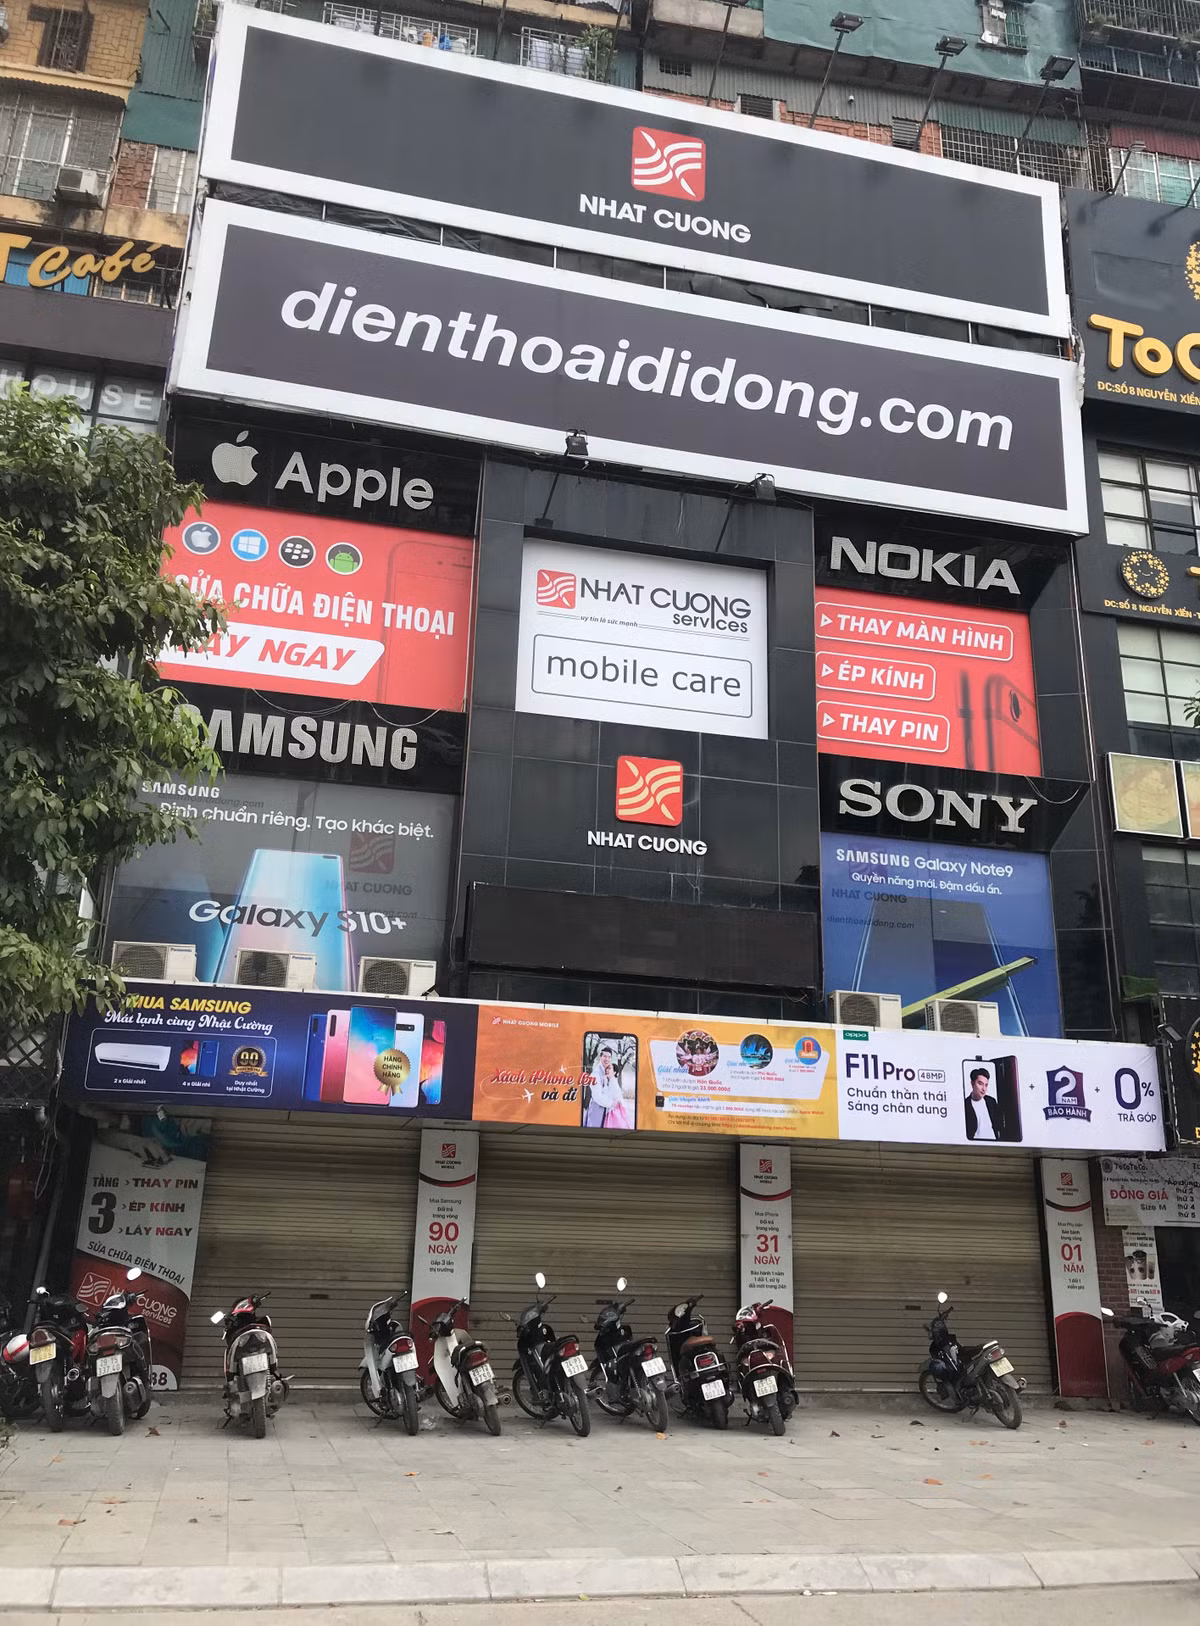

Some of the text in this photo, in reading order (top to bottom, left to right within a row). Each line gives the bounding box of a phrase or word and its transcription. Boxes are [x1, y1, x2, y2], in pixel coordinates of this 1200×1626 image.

[579, 193, 752, 243] NHAT CUONG
[27, 241, 163, 287] Café
[281, 283, 1013, 451] dienthoaididong.com
[1137, 388, 1177, 402] NGUYỄN
[275, 451, 435, 510] Apple
[830, 536, 1021, 594] NOKIA
[580, 577, 751, 619] NHAT CUONG
[234, 582, 305, 616] CHỮA
[312, 592, 373, 627] ĐIỆN
[382, 603, 455, 639] THOẠI
[672, 611, 748, 633] services
[837, 613, 1004, 650] THAY MÀN HÌNH
[258, 638, 356, 671] NGAY
[547, 655, 741, 697] mobile care
[838, 660, 925, 690] ÉP KÍNH
[840, 713, 939, 741] THAY PIN
[142, 781, 220, 798] SAMSUNG
[839, 778, 1038, 834] SONY
[202, 805, 258, 823] chuẩn
[262, 809, 311, 832] riêng.
[316, 815, 348, 834] Tạo
[352, 814, 395, 835] khác
[398, 821, 434, 840] biệt.
[587, 830, 707, 855] NHAT CUONG
[836, 848, 910, 867] SAMSUNG
[914, 856, 967, 877] Galaxy
[971, 862, 1014, 878] Note9
[362, 882, 413, 896] CUONG
[851, 871, 1003, 895] Quyền năng mới. Đậm dấu ấn.
[831, 887, 908, 904] NHAT CUONG
[189, 900, 329, 937] Galaxy
[338, 909, 408, 935] S10+
[170, 997, 252, 1014] SAMSUNG
[104, 1010, 273, 1035] Mát lạnh cùng Nhật Cường
[529, 1069, 575, 1086] iPhone
[845, 1052, 944, 1082] F11 Pro 48MP
[541, 1087, 578, 1102] và đi
[847, 1085, 947, 1102] Chuẩn thần thái
[1054, 1069, 1077, 1104] 2
[1114, 1067, 1155, 1110] 0%
[847, 1100, 948, 1119] Sáng chân dung
[1065, 1105, 1087, 1118] HÀNH
[1117, 1111, 1157, 1123] TRẢ GÓP
[133, 1178, 172, 1188] THAY
[175, 1179, 199, 1189] PIN
[1147, 1187, 1168, 1201] GIÁ
[88, 1191, 186, 1235] 3 ÉP KÍNH
[1140, 1203, 1157, 1211] Size
[155, 1227, 193, 1237] NGAY
[428, 1221, 459, 1242] 90
[756, 1233, 779, 1253] 31
[427, 1242, 458, 1255] NGÀY
[753, 1254, 781, 1266] NGÀY
[1061, 1243, 1082, 1261] 01
[87, 1240, 185, 1285] SỬA CHỮA ĐIỆN THOẠI
[1063, 1262, 1085, 1273] NĂM
[136, 1294, 178, 1317] CUONG
[141, 1308, 172, 1325] services
